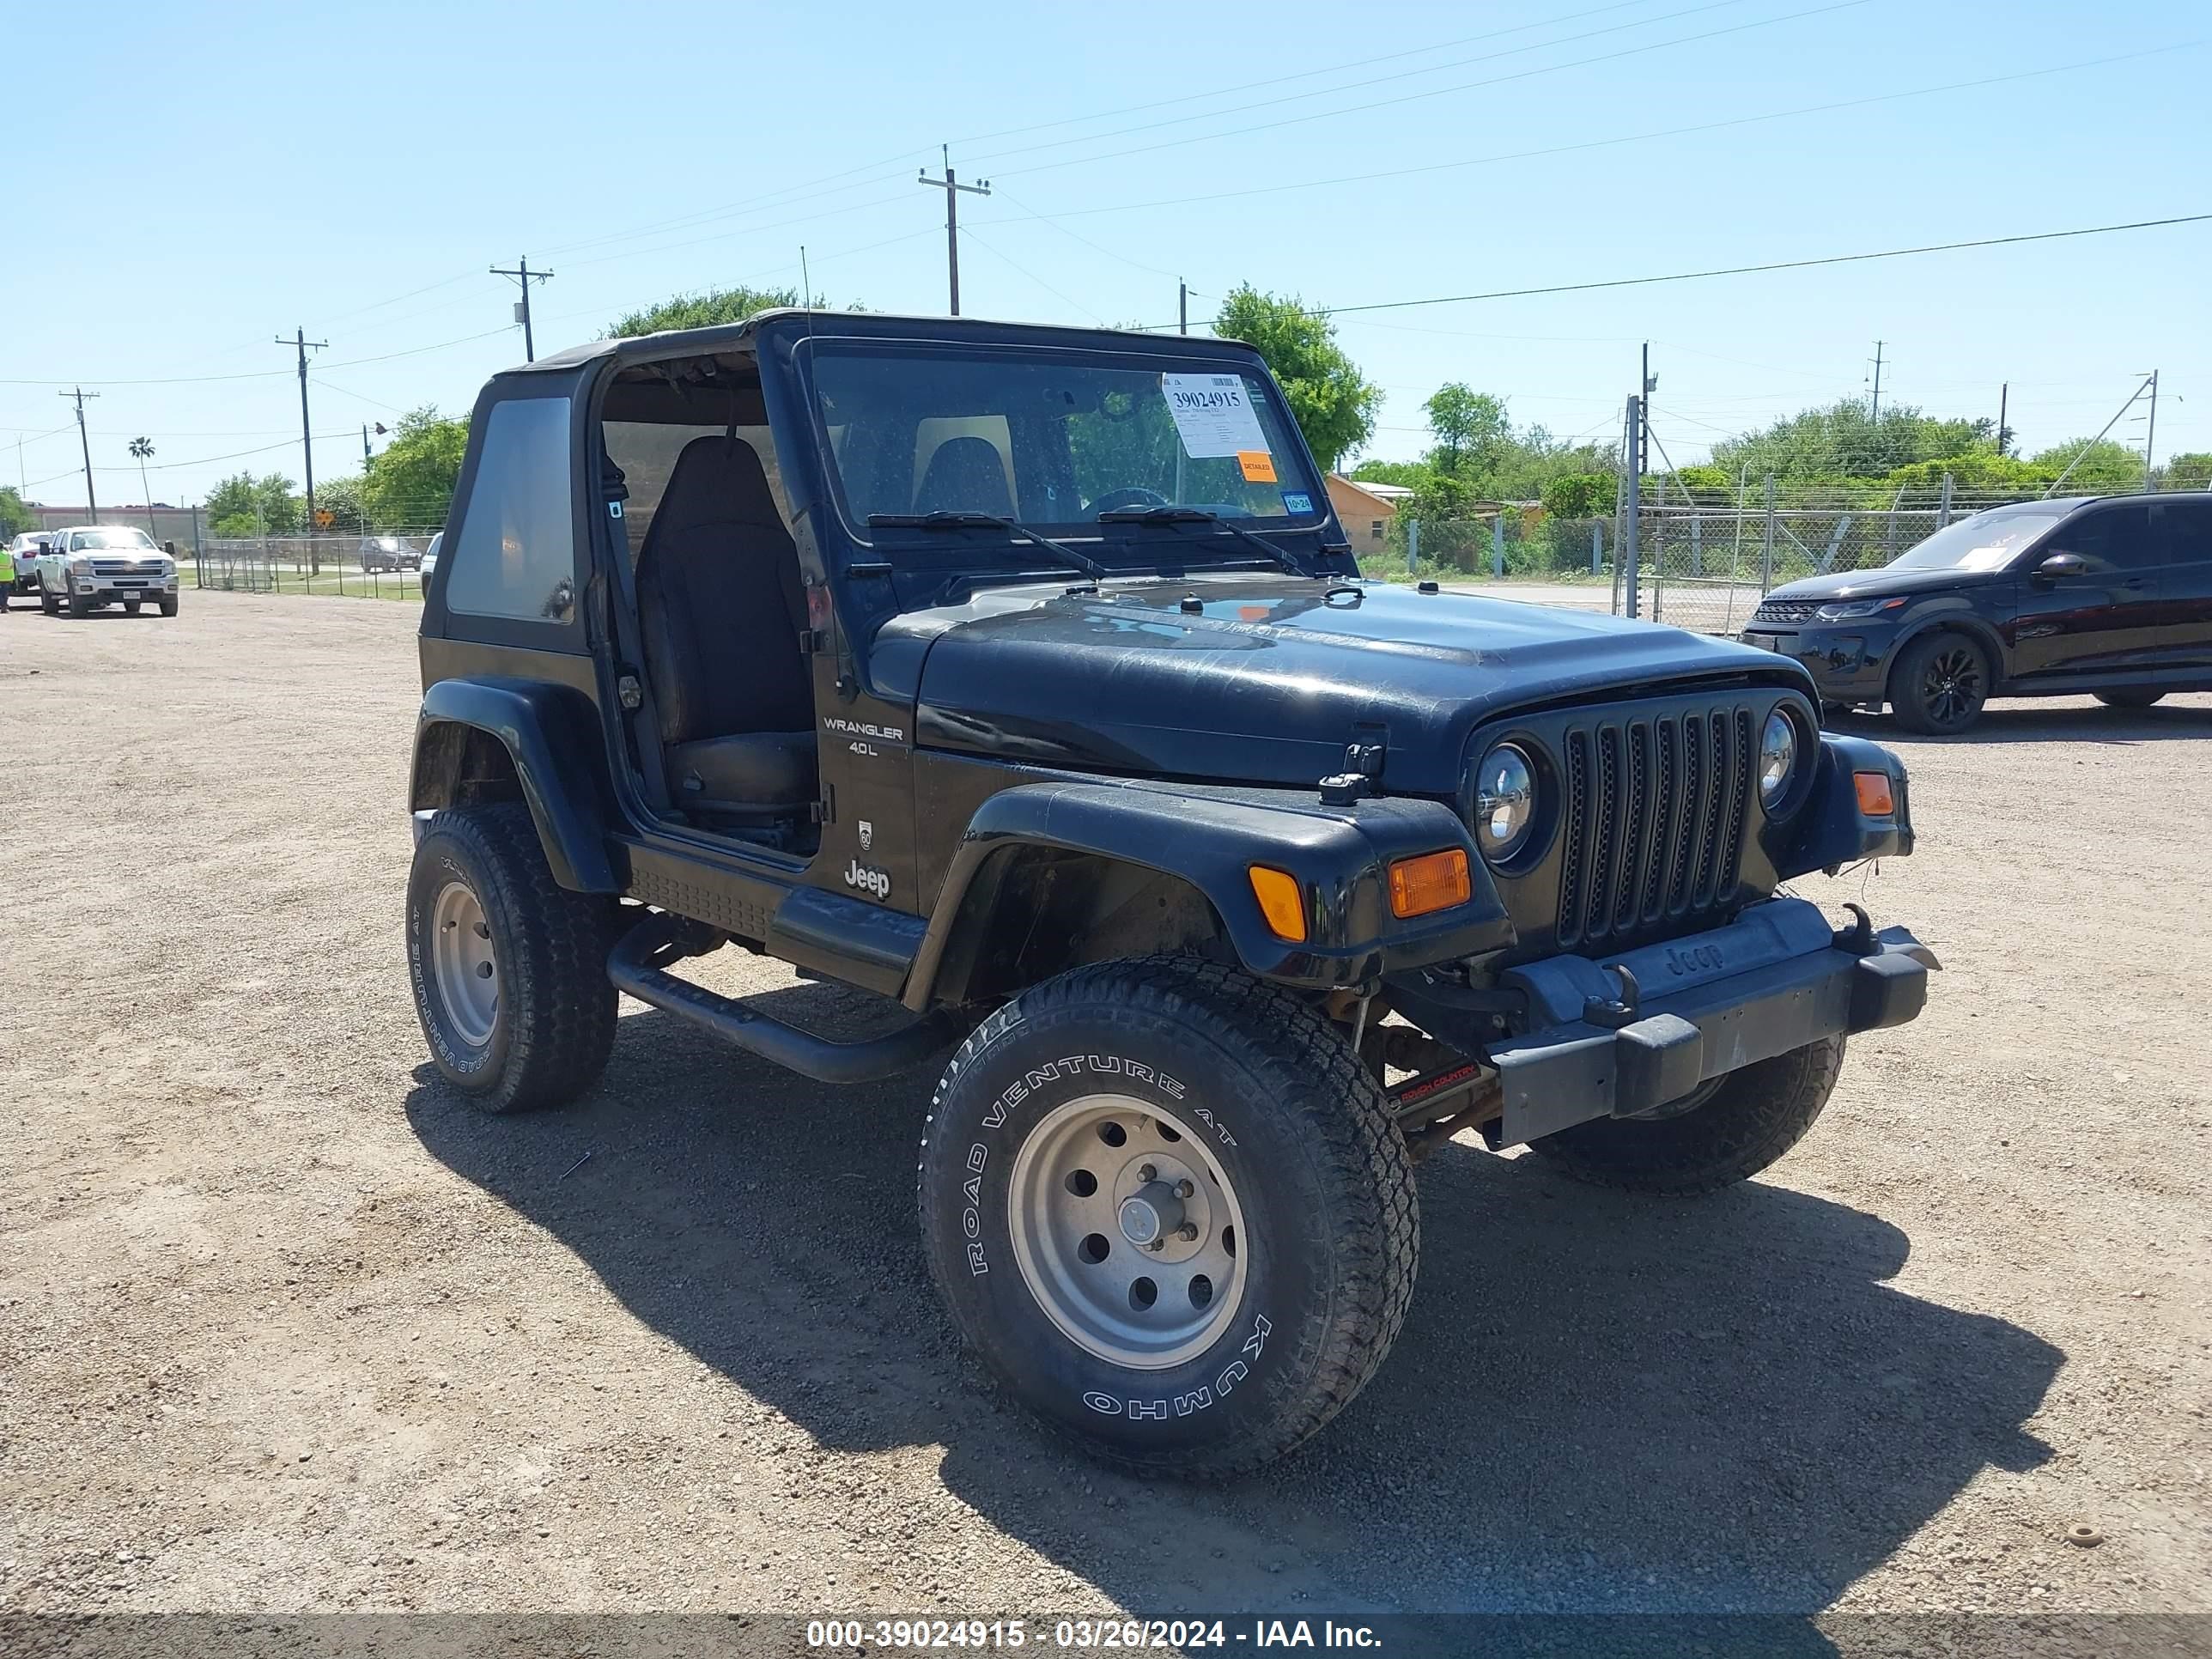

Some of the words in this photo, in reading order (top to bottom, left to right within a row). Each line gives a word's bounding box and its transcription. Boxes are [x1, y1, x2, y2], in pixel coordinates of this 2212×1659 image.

[1173, 391, 1241, 408] 39024915
[823, 717, 903, 741] WRANGLER
[844, 860, 890, 898] Jeep
[412, 904, 421, 937] AT
[1665, 945, 1724, 976] Jeep
[411, 942, 456, 1066] VENTURE
[1401, 1083, 1433, 1102] ROUGH
[1433, 1064, 1476, 1088] COUNTRY
[962, 1142, 990, 1277] ROAD
[981, 1054, 1186, 1129] VENTURE
[1194, 1107, 1238, 1147] AT
[1082, 1313, 1273, 1421] KUMHO
